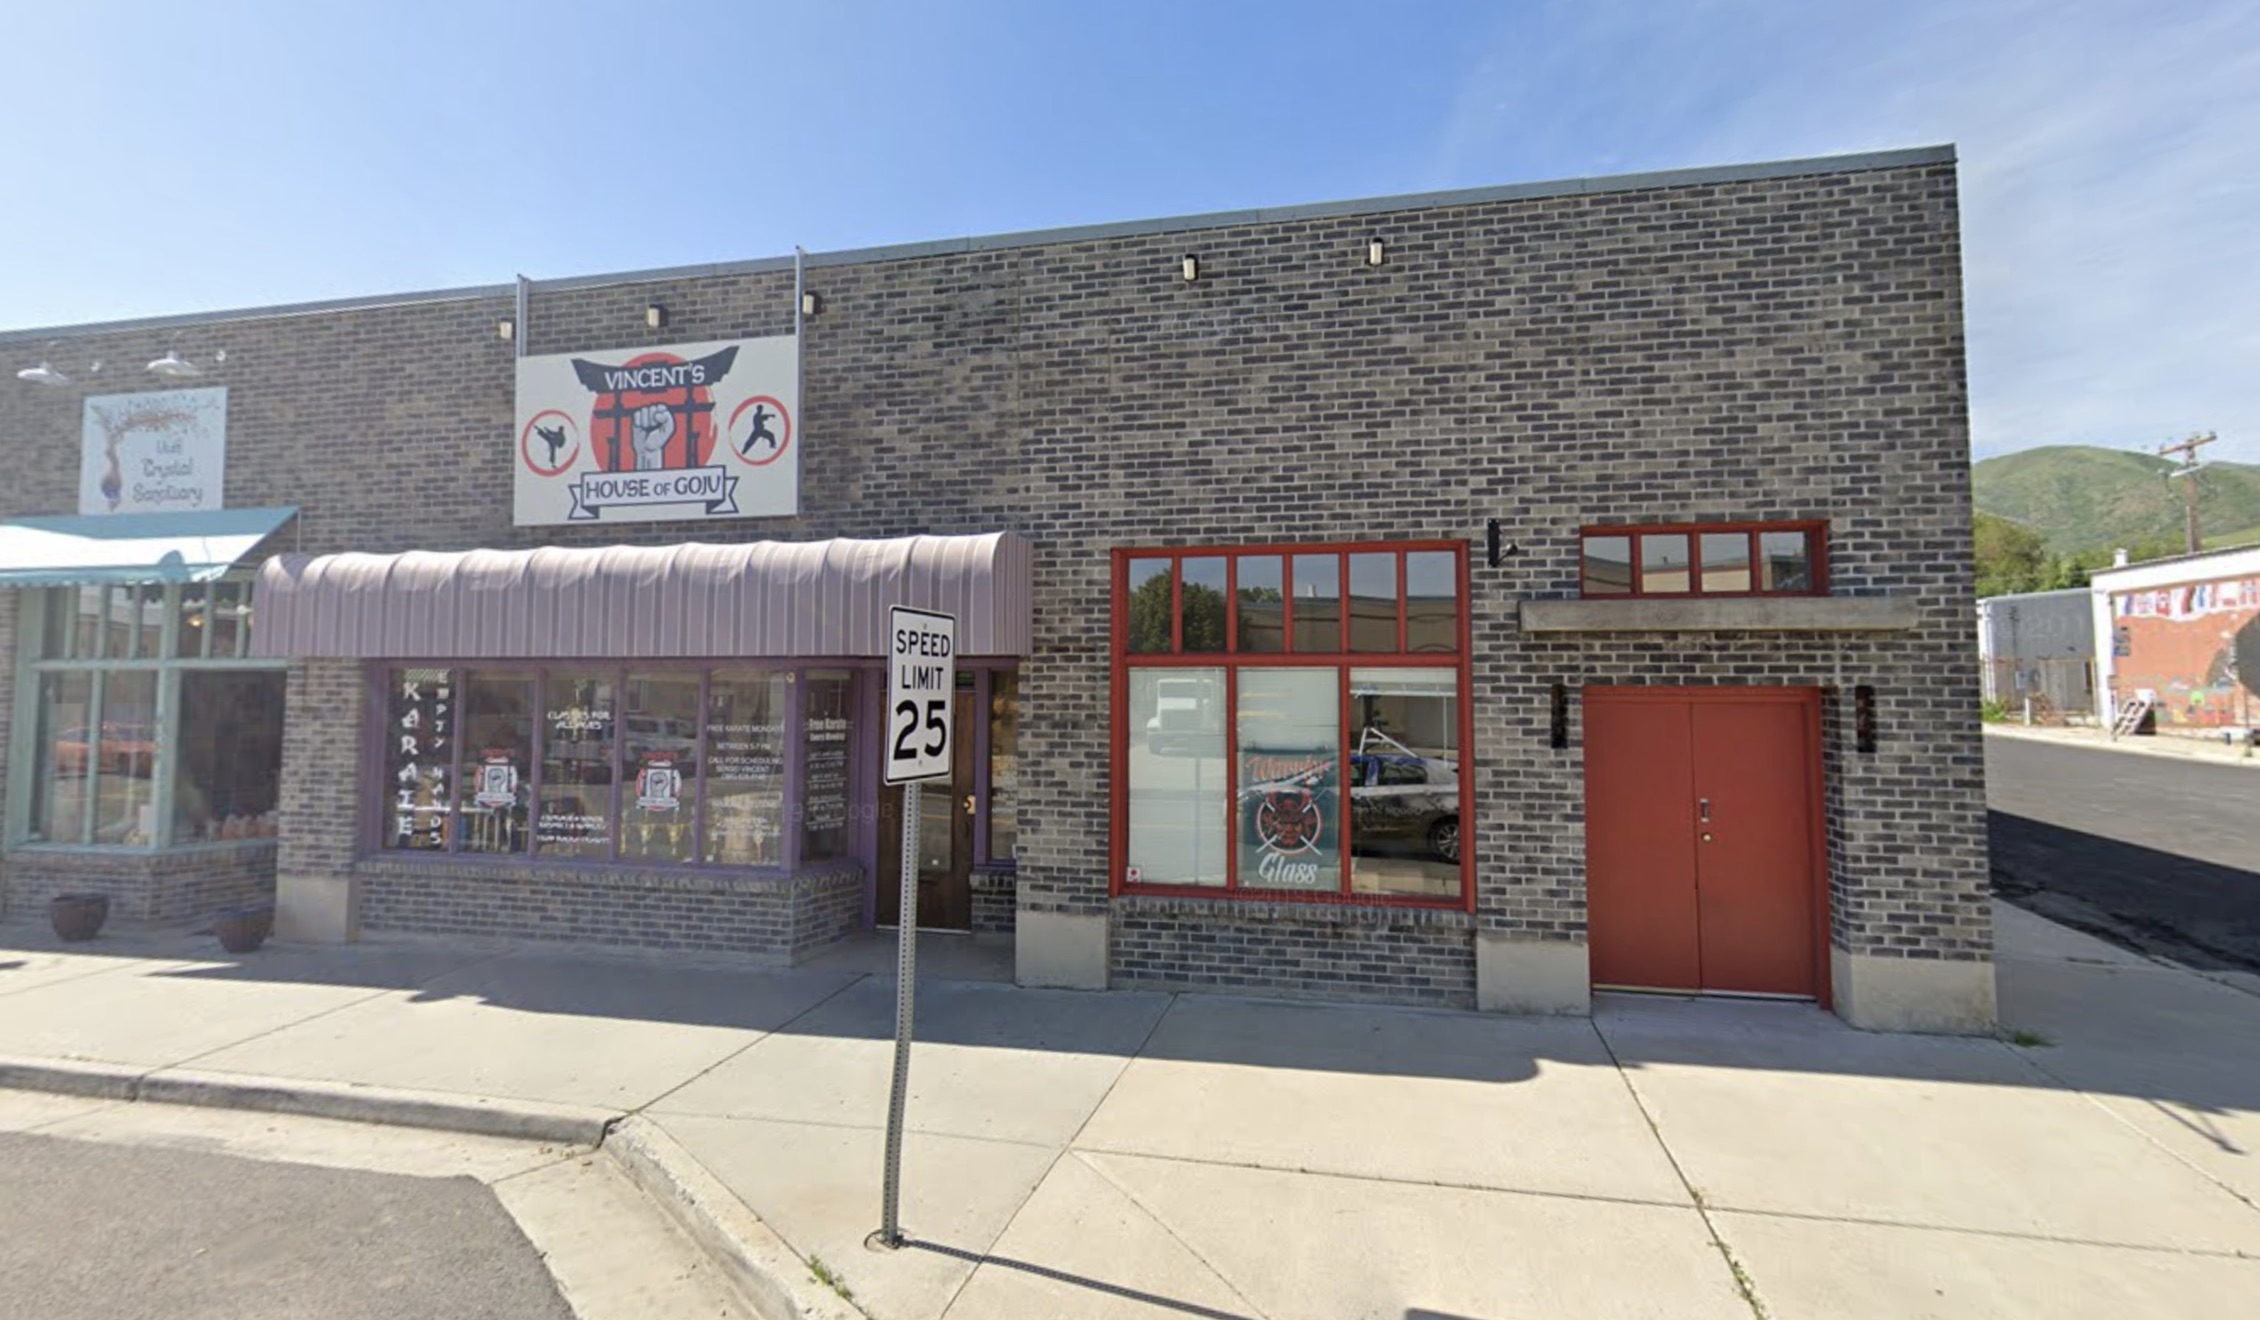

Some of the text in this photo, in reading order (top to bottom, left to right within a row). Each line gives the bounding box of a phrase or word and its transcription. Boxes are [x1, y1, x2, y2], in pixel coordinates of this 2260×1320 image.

[604, 363, 706, 390] VINCENT'S
[140, 456, 193, 478] Crystal
[133, 482, 203, 507] Sanctuary
[585, 479, 650, 499] HOUSE
[673, 475, 722, 496] GOJU
[896, 629, 951, 657] SPEED
[901, 664, 943, 690] LIMIT
[893, 699, 947, 761] 25
[397, 682, 421, 836] KARATE
[1258, 852, 1319, 885] Glass
